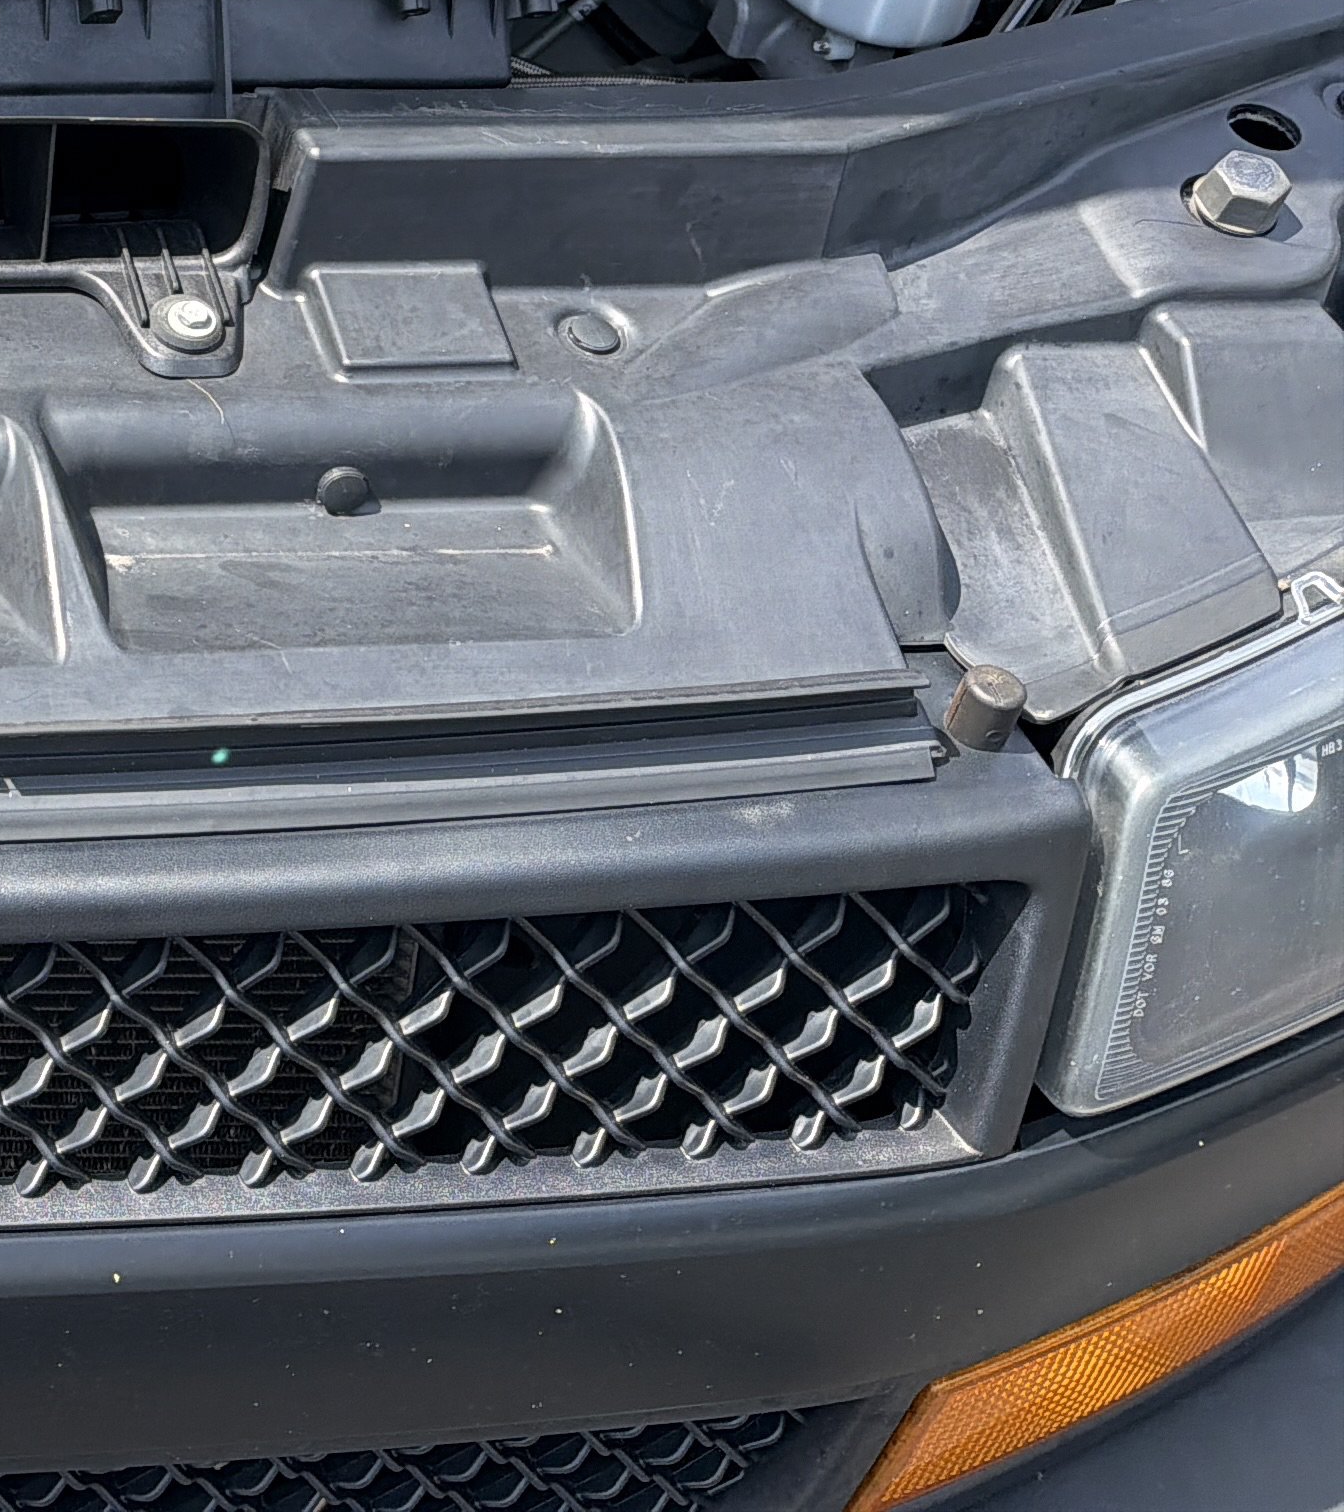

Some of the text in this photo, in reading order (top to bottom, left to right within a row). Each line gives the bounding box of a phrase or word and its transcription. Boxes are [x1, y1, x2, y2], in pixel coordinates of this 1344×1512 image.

[1321, 738, 1343, 757] HB3
[1132, 990, 1150, 1017] DOT
[1141, 953, 1158, 982] VOR
[1155, 897, 1170, 916] 03
